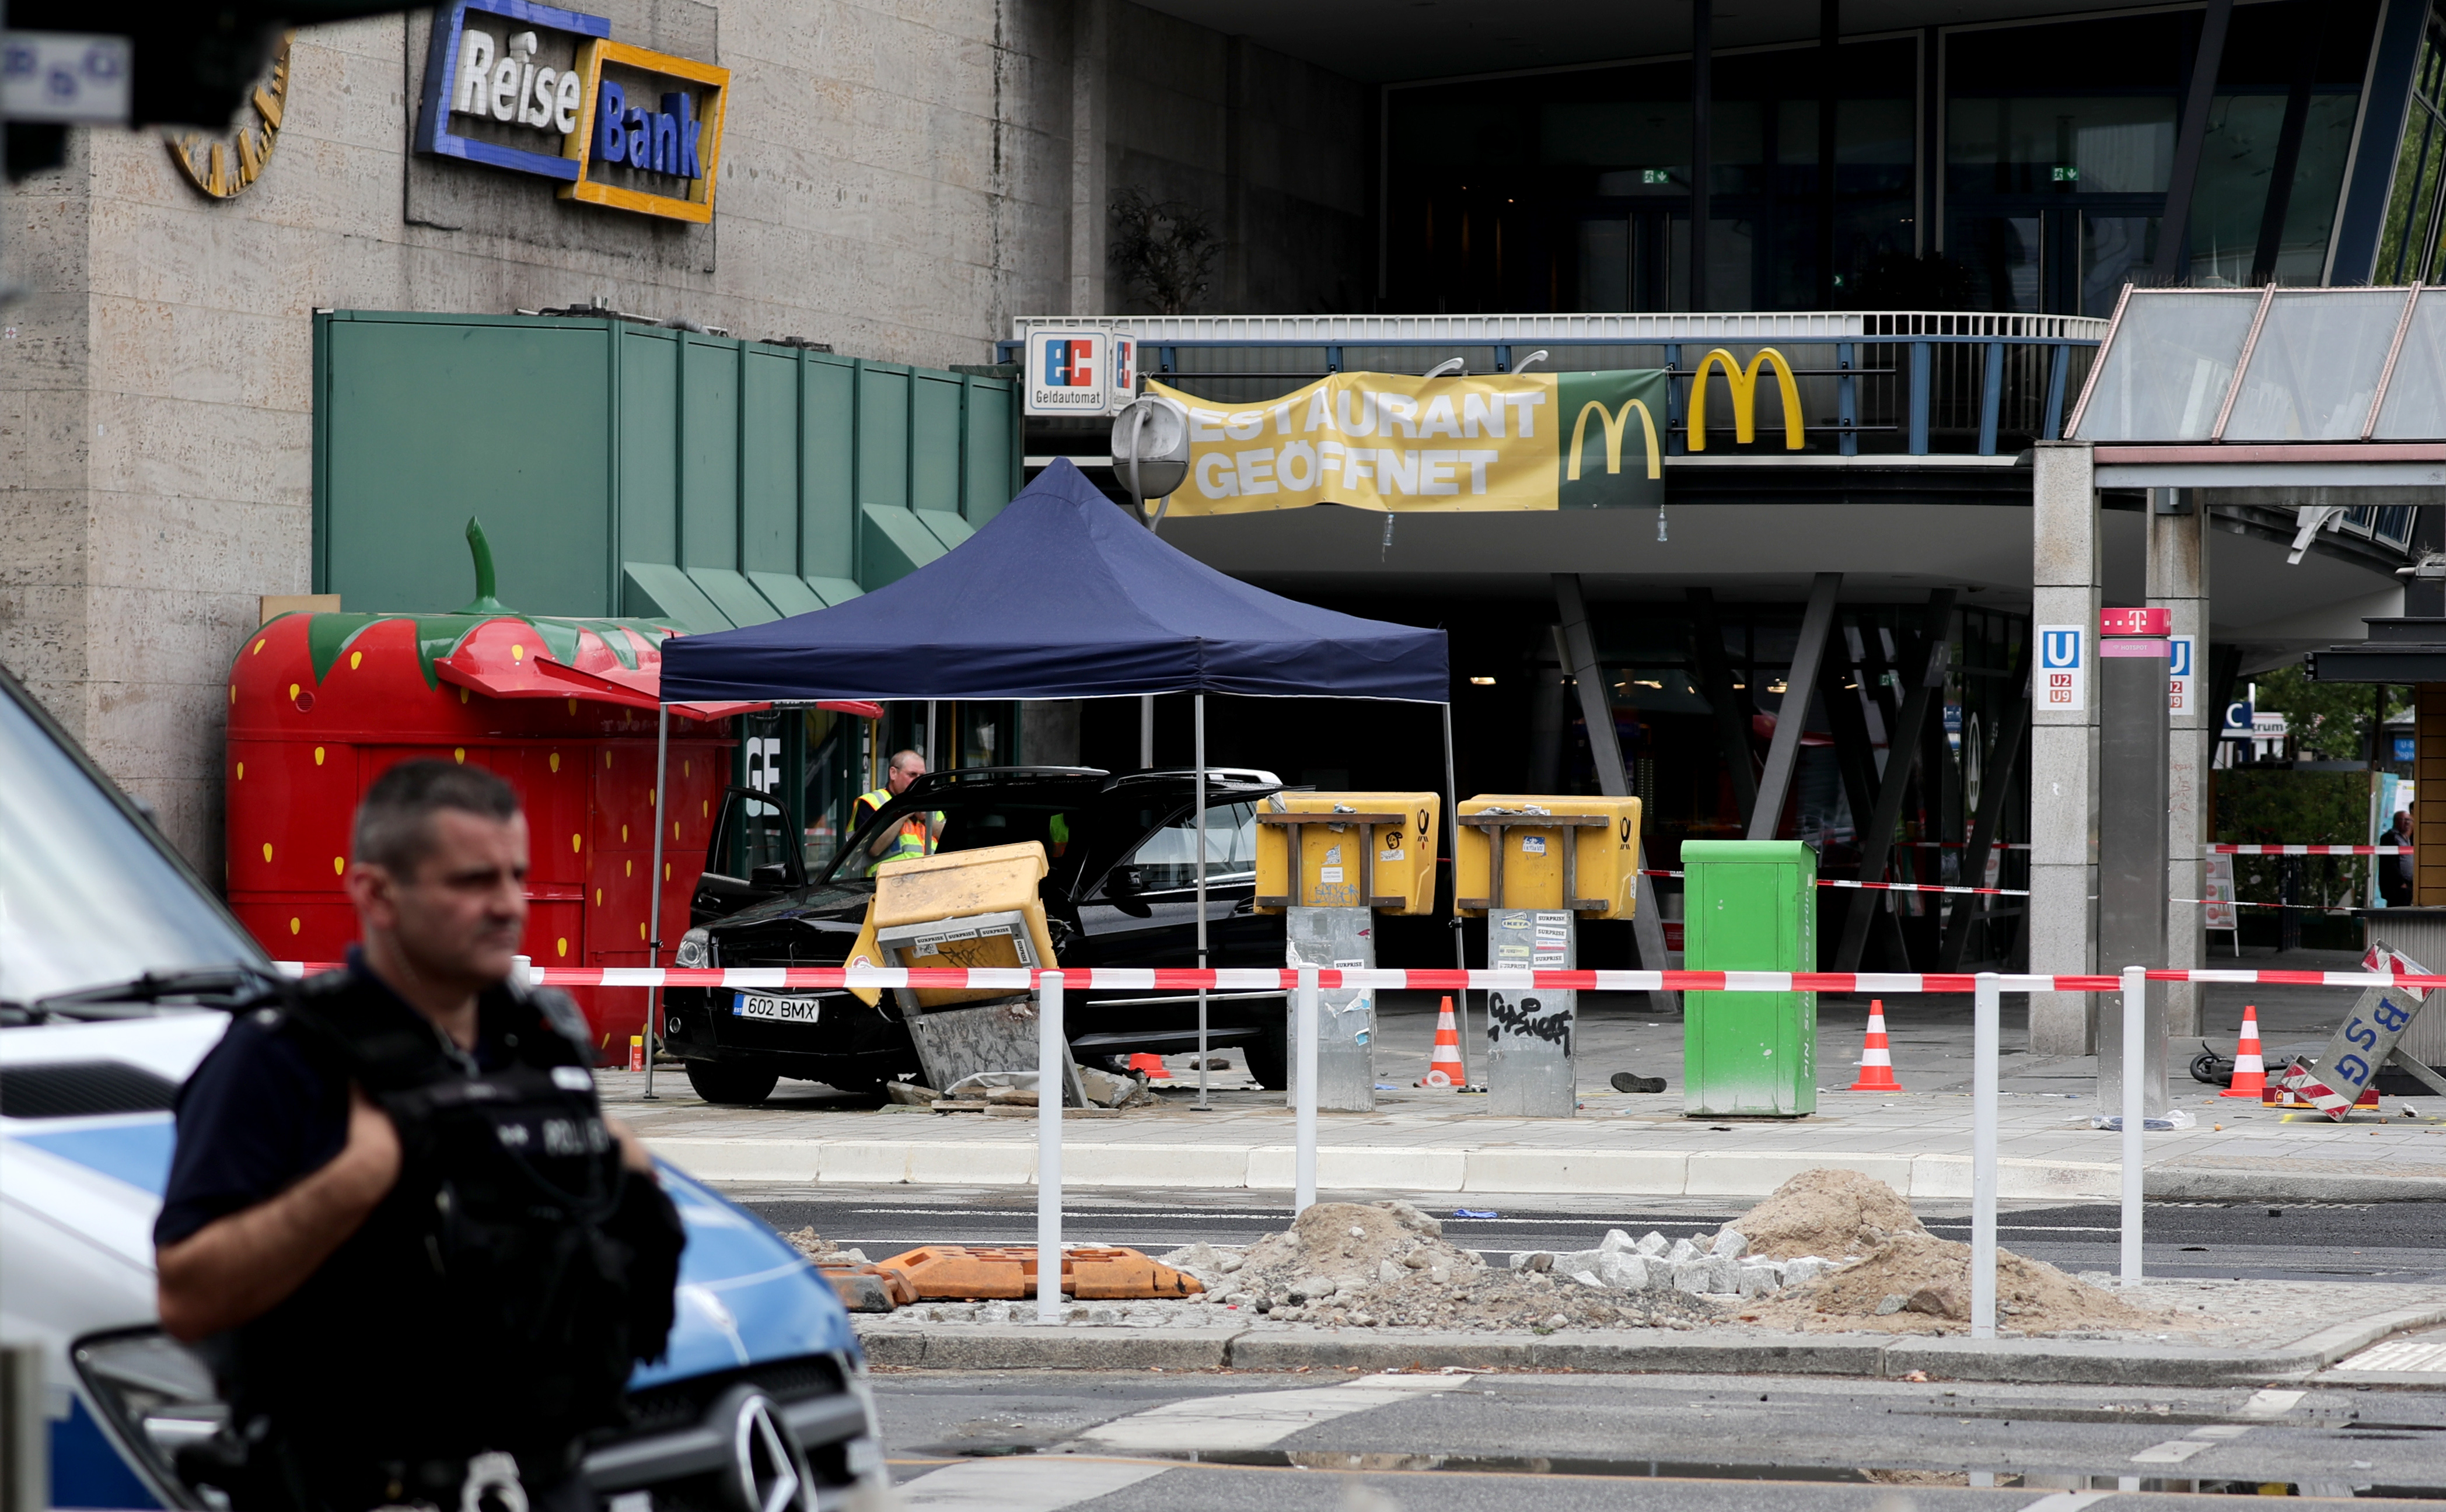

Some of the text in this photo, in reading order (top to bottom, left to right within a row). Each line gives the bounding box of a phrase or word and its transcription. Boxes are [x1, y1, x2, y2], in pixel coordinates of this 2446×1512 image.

[450, 29, 702, 180] Reise Bank
[1036, 390, 1100, 404] Geldautomat
[1165, 386, 1546, 443] ESTAURANT
[1195, 439, 1498, 500] GEÖFFNET
[2048, 633, 2075, 667] U
[2052, 675, 2070, 687] U2
[2169, 682, 2182, 692] 2
[2052, 691, 2070, 702] U9
[2169, 698, 2182, 707] 9
[948, 931, 976, 939] SURPRISE
[981, 928, 1010, 936] SURPRISE
[917, 936, 945, 944] SURPRISE
[1017, 940, 1028, 963] SURPRISE
[748, 998, 816, 1020] 602 BMX
[2334, 997, 2410, 1087] BSG
